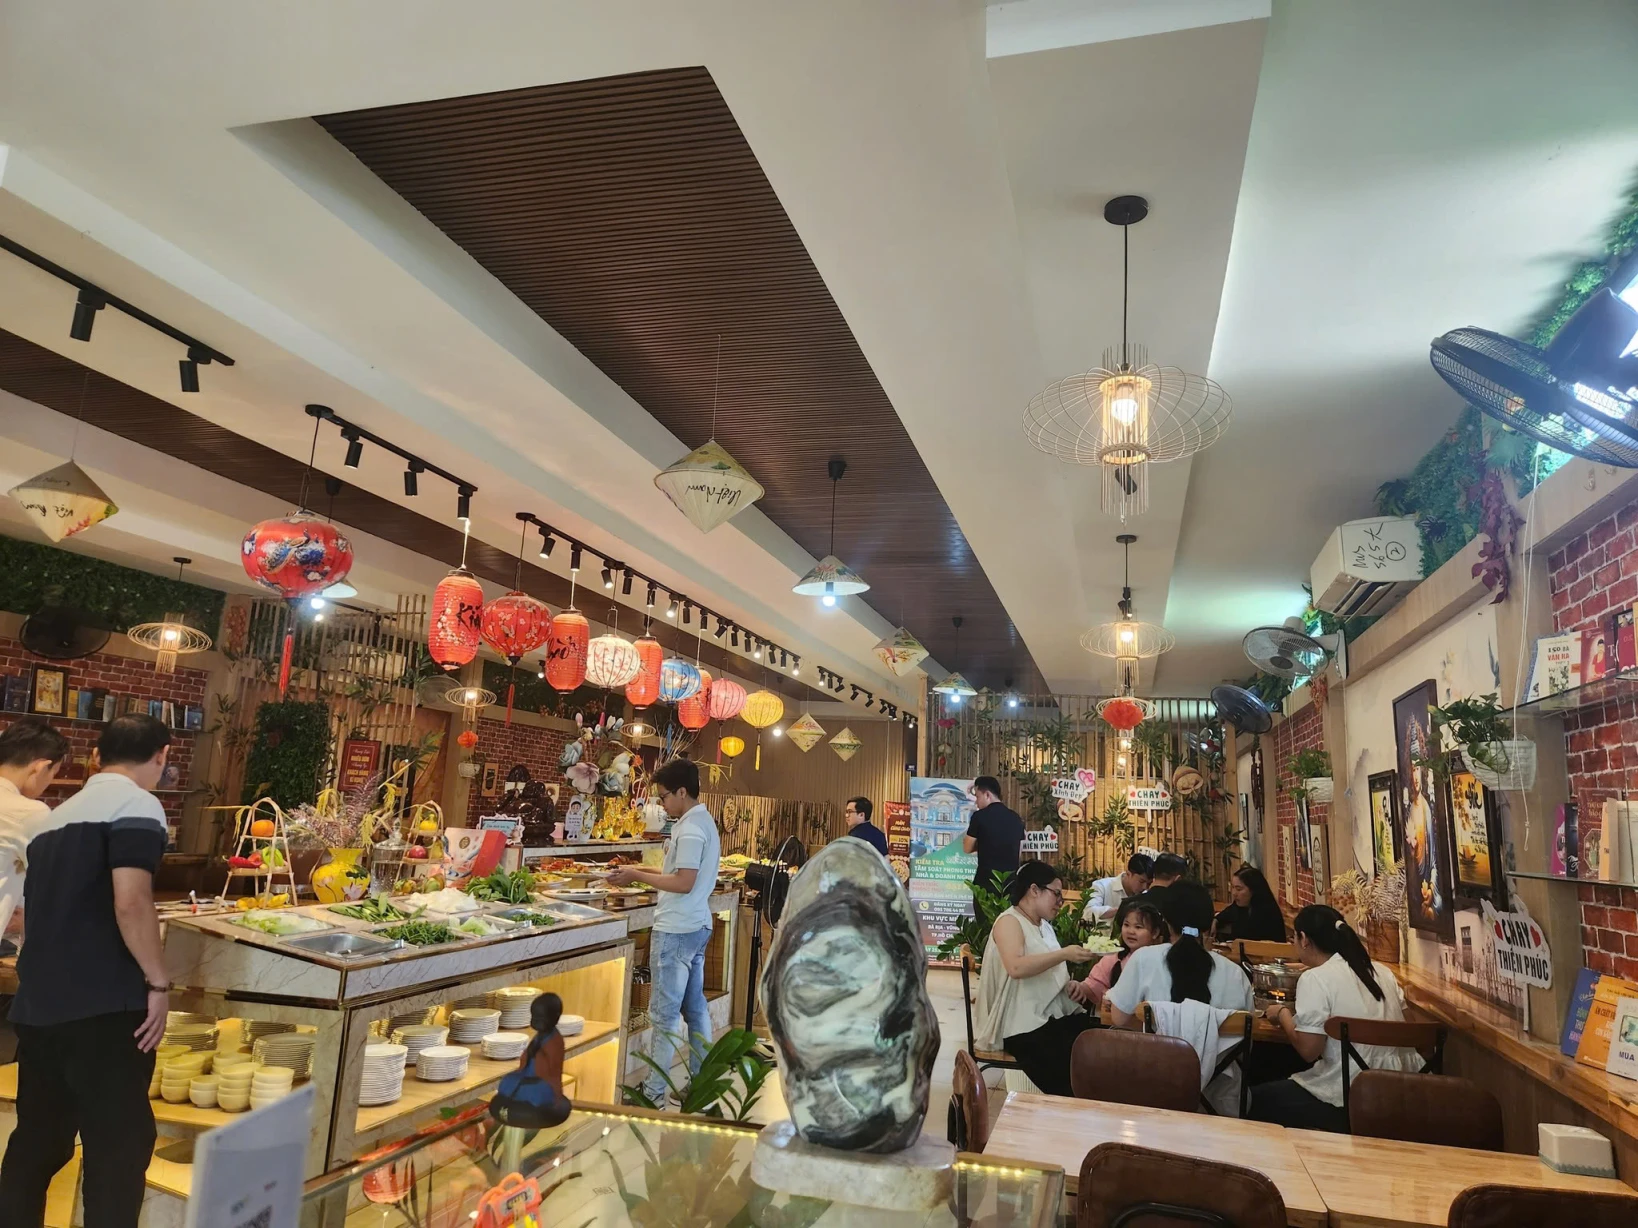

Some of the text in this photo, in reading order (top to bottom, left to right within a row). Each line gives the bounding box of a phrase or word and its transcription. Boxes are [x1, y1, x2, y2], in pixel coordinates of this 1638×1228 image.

[1058, 780, 1080, 790] CHAY
[1028, 833, 1048, 841] CHAY
[1502, 919, 1531, 949] CHAY
[1524, 954, 1549, 981] PHÚC
